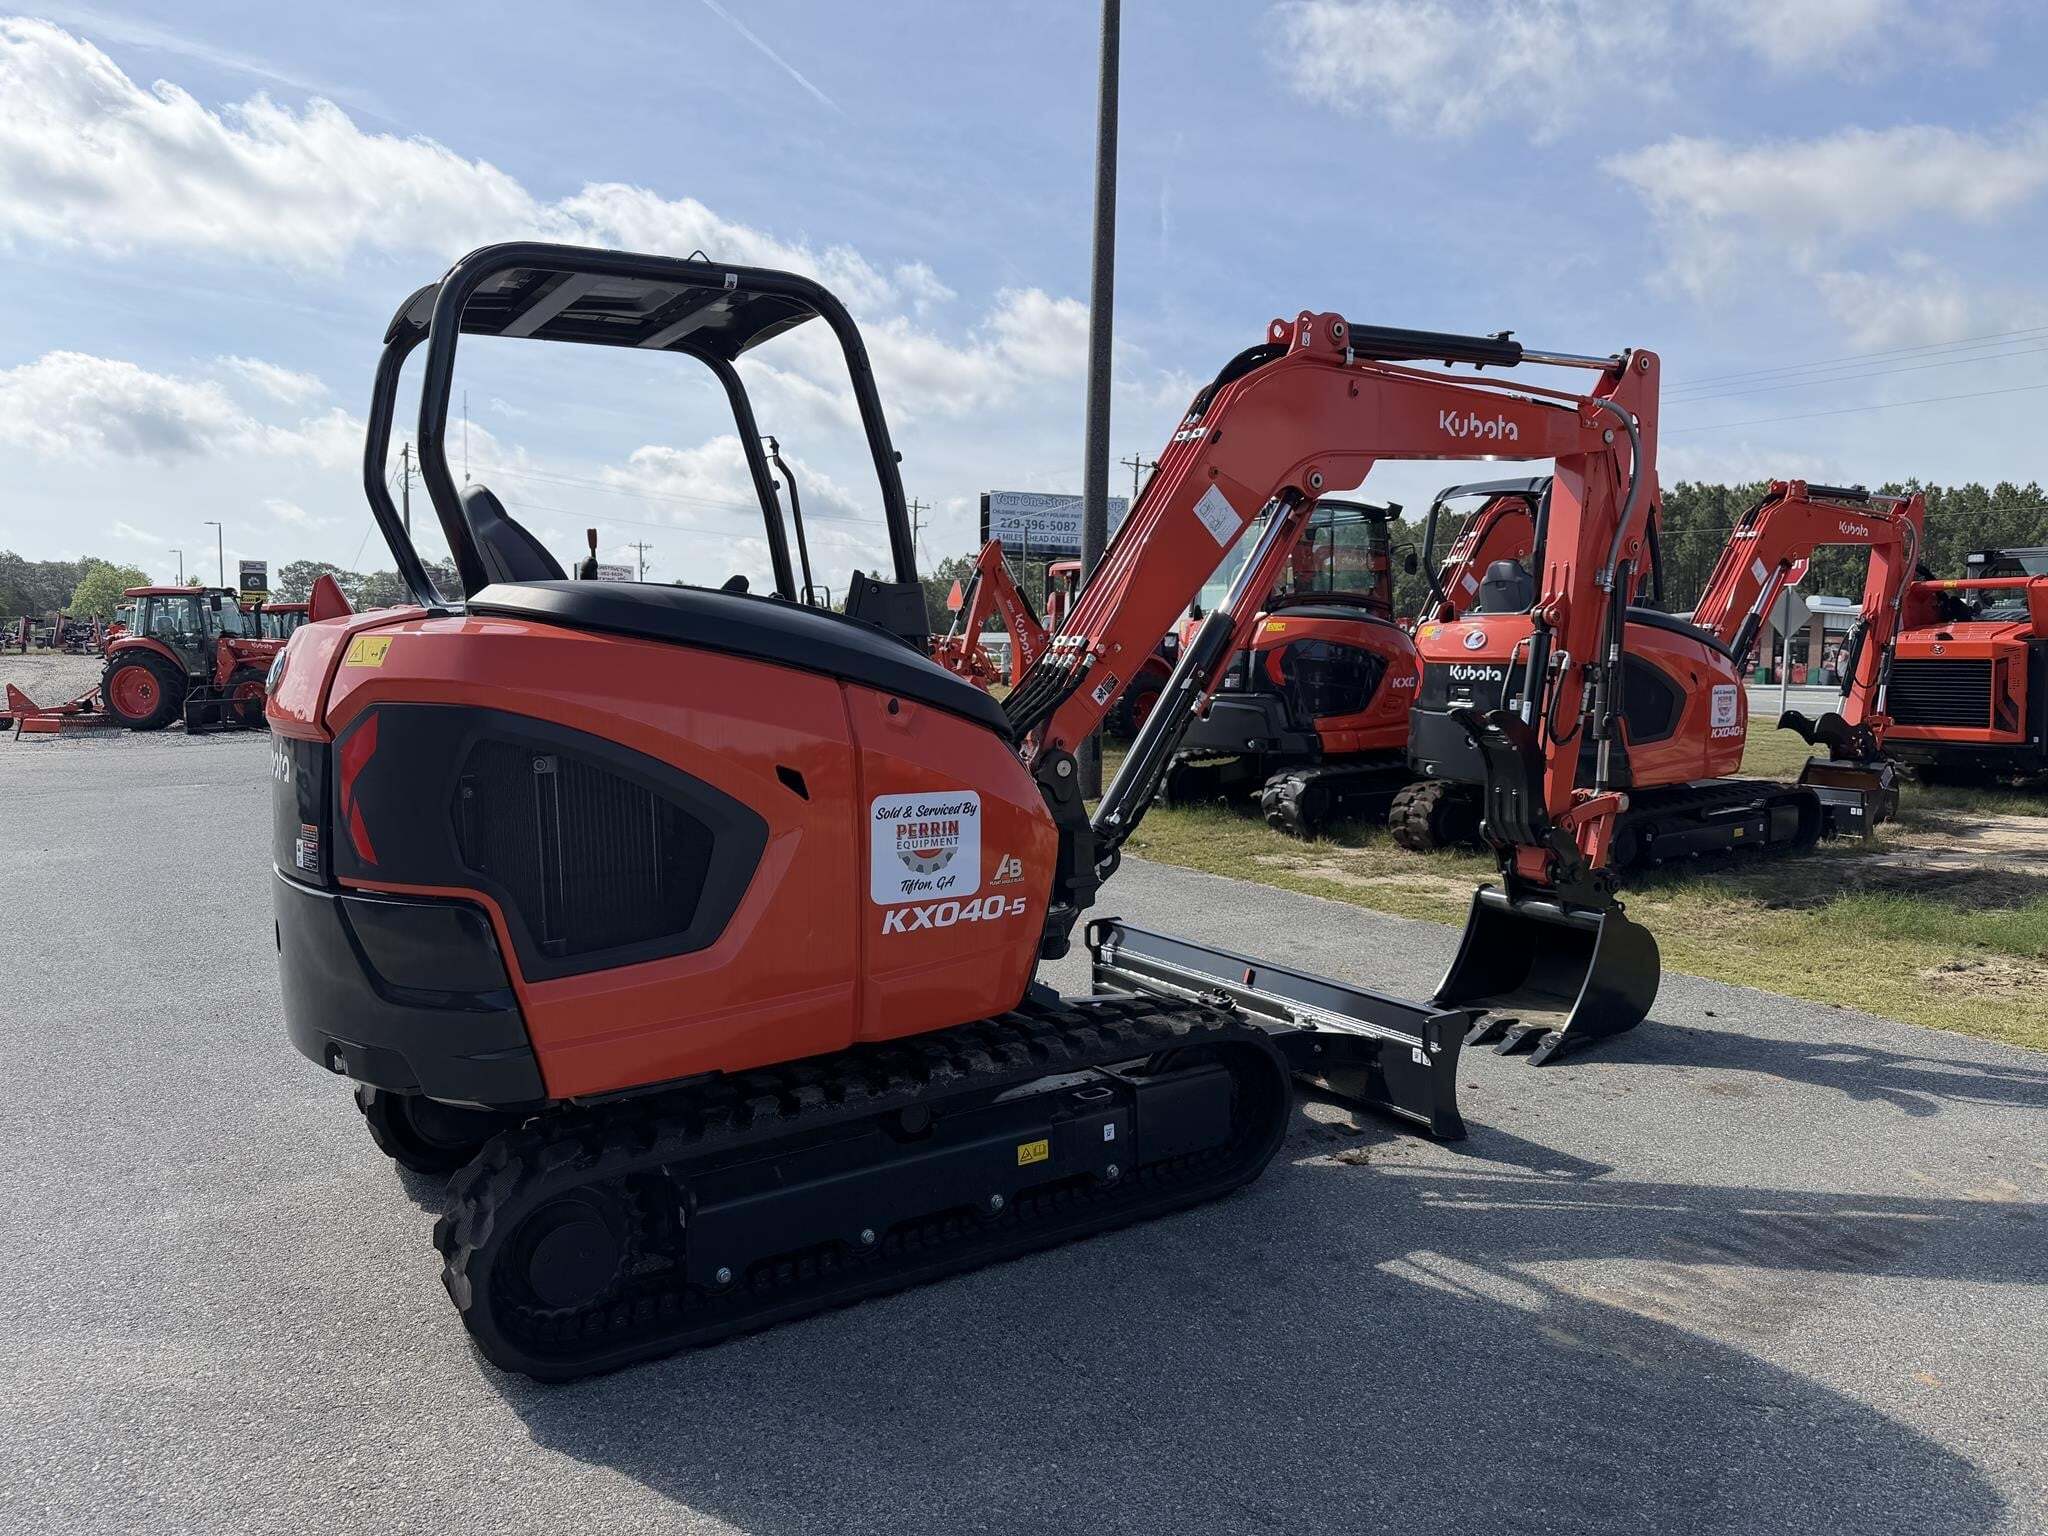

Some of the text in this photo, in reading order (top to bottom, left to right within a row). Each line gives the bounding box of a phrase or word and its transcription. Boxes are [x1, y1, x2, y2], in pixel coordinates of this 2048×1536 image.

[1439, 409, 1518, 441] Kubota
[996, 494, 1019, 506] Your
[1838, 520, 1869, 537] Kubota
[1003, 533, 1023, 541] MILES
[1062, 537, 1079, 545] LEFT
[1014, 613, 1034, 665] Kubota
[1449, 665, 1502, 681] Kubota
[875, 801, 978, 820] Sold & Serviced By
[896, 820, 960, 840] PERRIN
[896, 836, 960, 850] EQUIPMENT
[901, 875, 956, 895] Tifton, GA
[881, 895, 1027, 935] KX040-5
